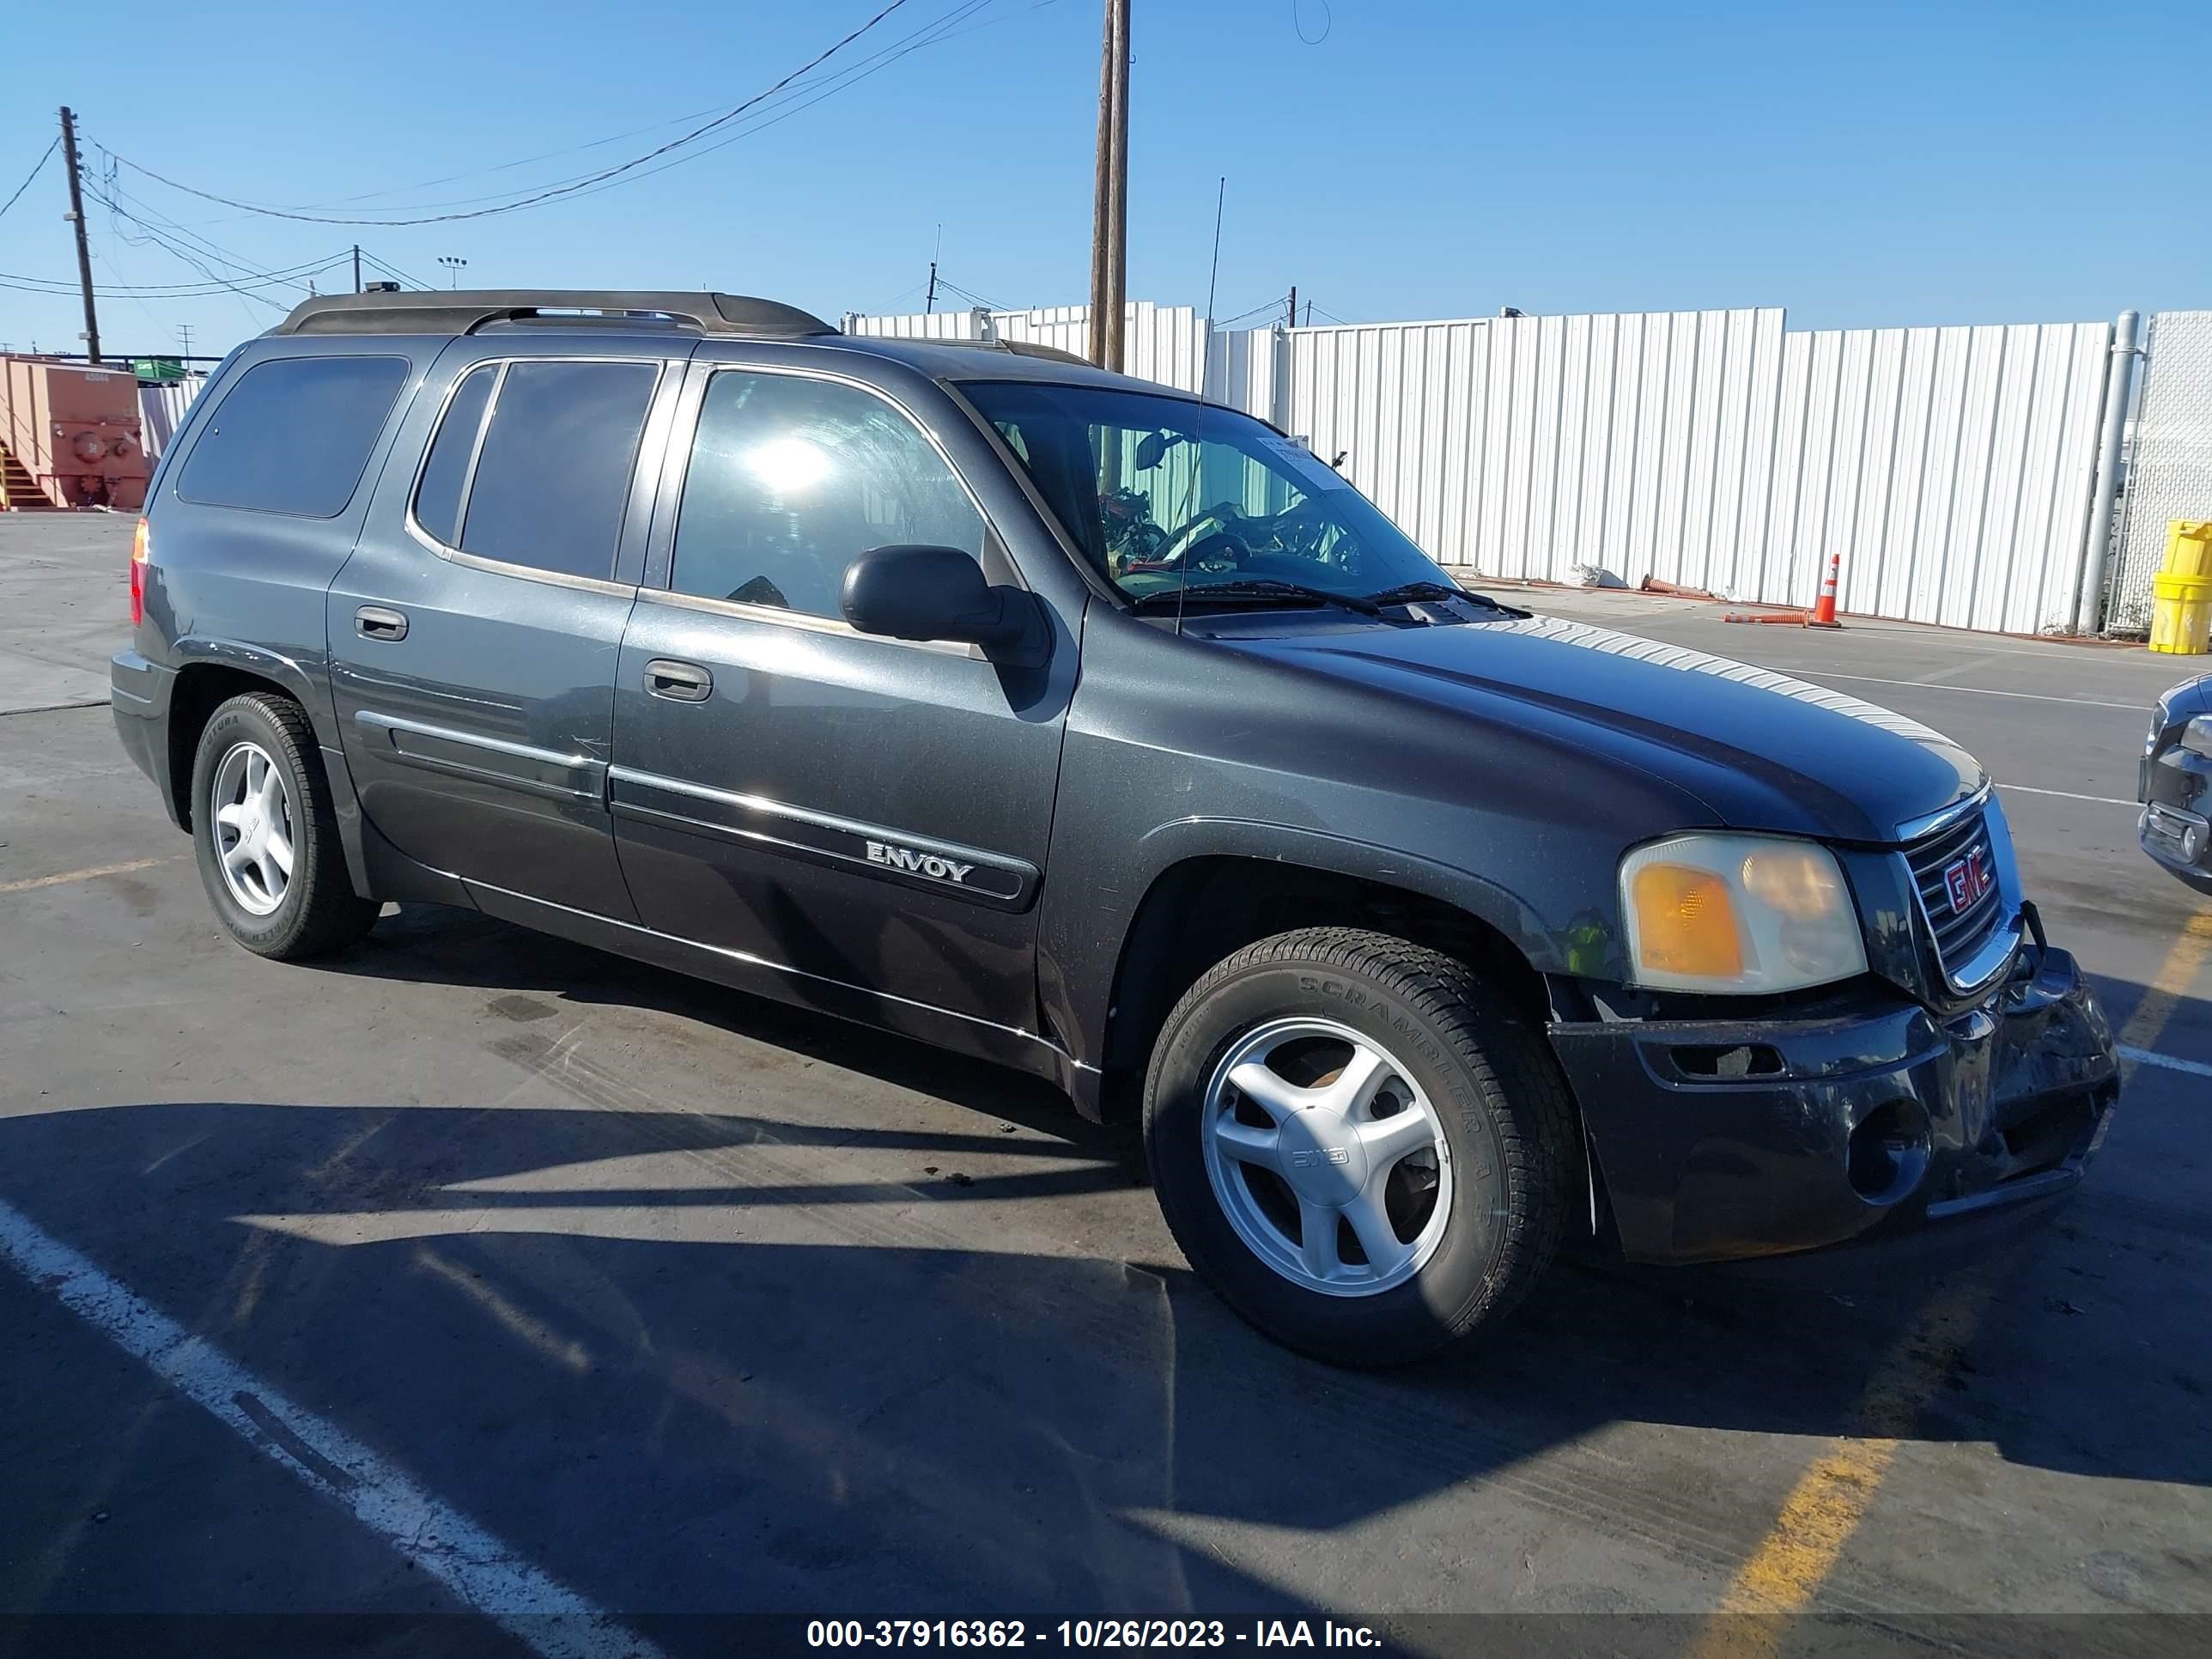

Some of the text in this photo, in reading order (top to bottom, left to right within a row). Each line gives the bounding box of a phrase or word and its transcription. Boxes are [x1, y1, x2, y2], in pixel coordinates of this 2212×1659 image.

[866, 841, 975, 883] ENVOY
[1944, 844, 1990, 915] GMC
[1299, 976, 1481, 1134] SCRAMBLER
